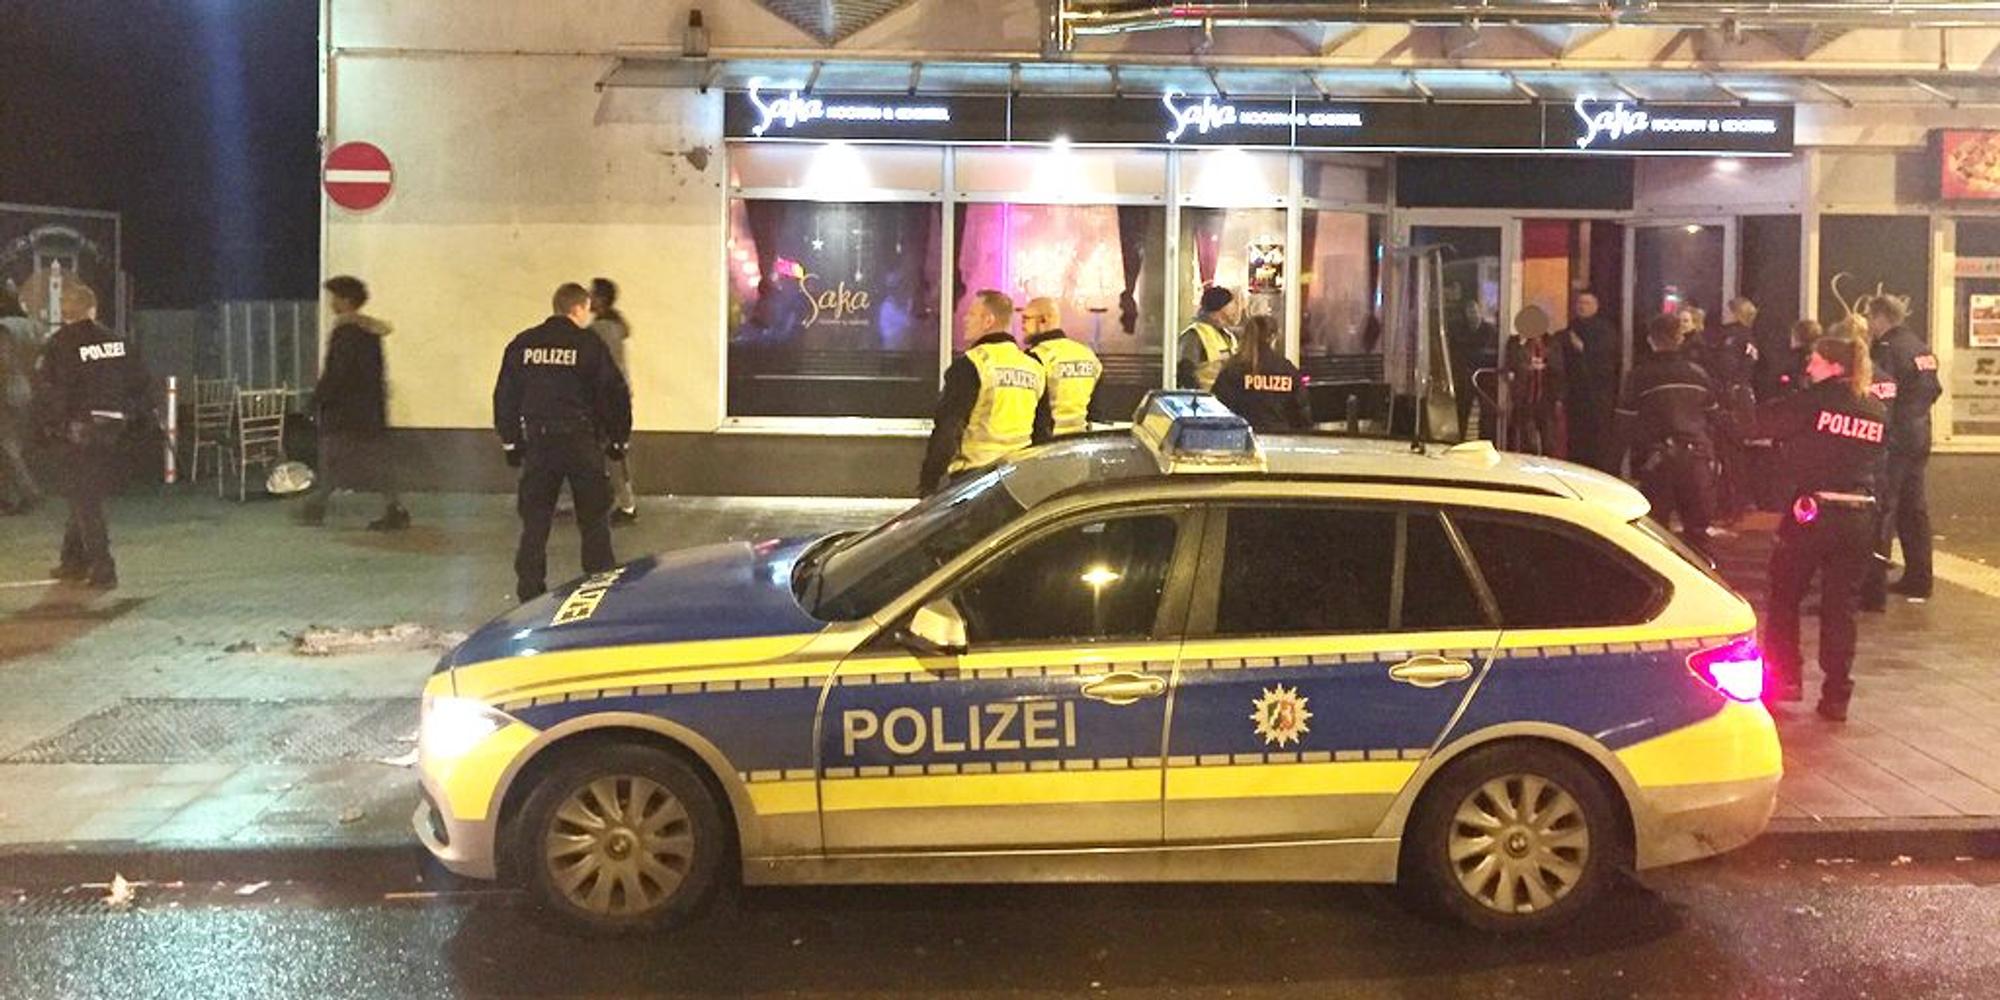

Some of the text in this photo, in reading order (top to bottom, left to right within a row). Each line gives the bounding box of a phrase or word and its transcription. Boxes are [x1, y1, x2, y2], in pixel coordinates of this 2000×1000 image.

[801, 273, 871, 328] Saka
[79, 341, 126, 362] POLIZEI
[523, 348, 577, 366] POLIZEI
[1244, 374, 1293, 392] POLIZEI
[1817, 411, 1884, 443] POLIZEI
[843, 701, 1076, 756] POLIZEI
